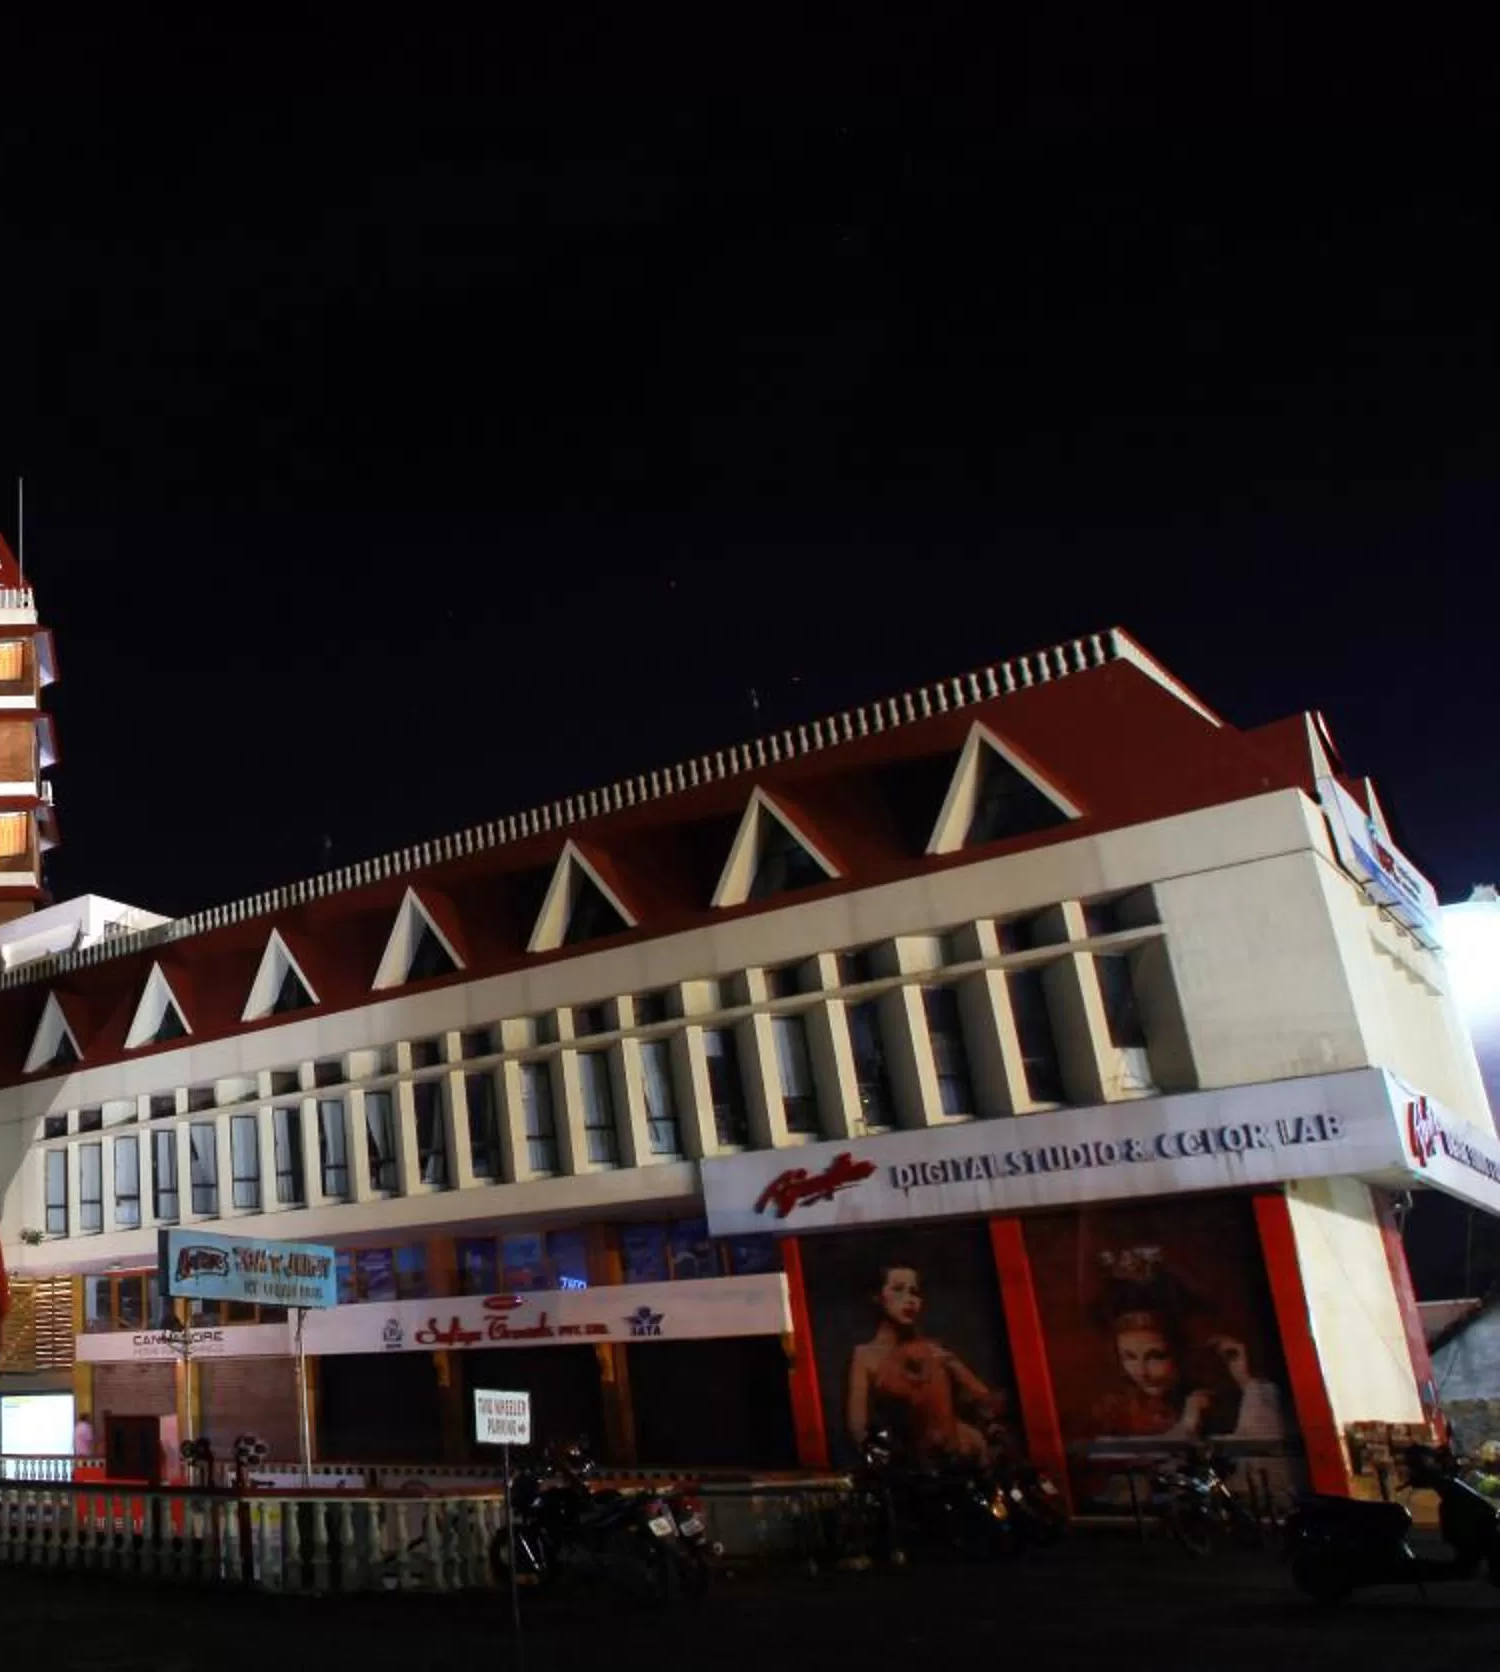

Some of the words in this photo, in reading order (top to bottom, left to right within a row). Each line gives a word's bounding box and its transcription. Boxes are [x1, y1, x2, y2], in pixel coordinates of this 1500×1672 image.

[889, 1151, 998, 1190] DIGITAL
[1003, 1137, 1118, 1177] STUDIO
[1275, 1112, 1347, 1147] LAB
